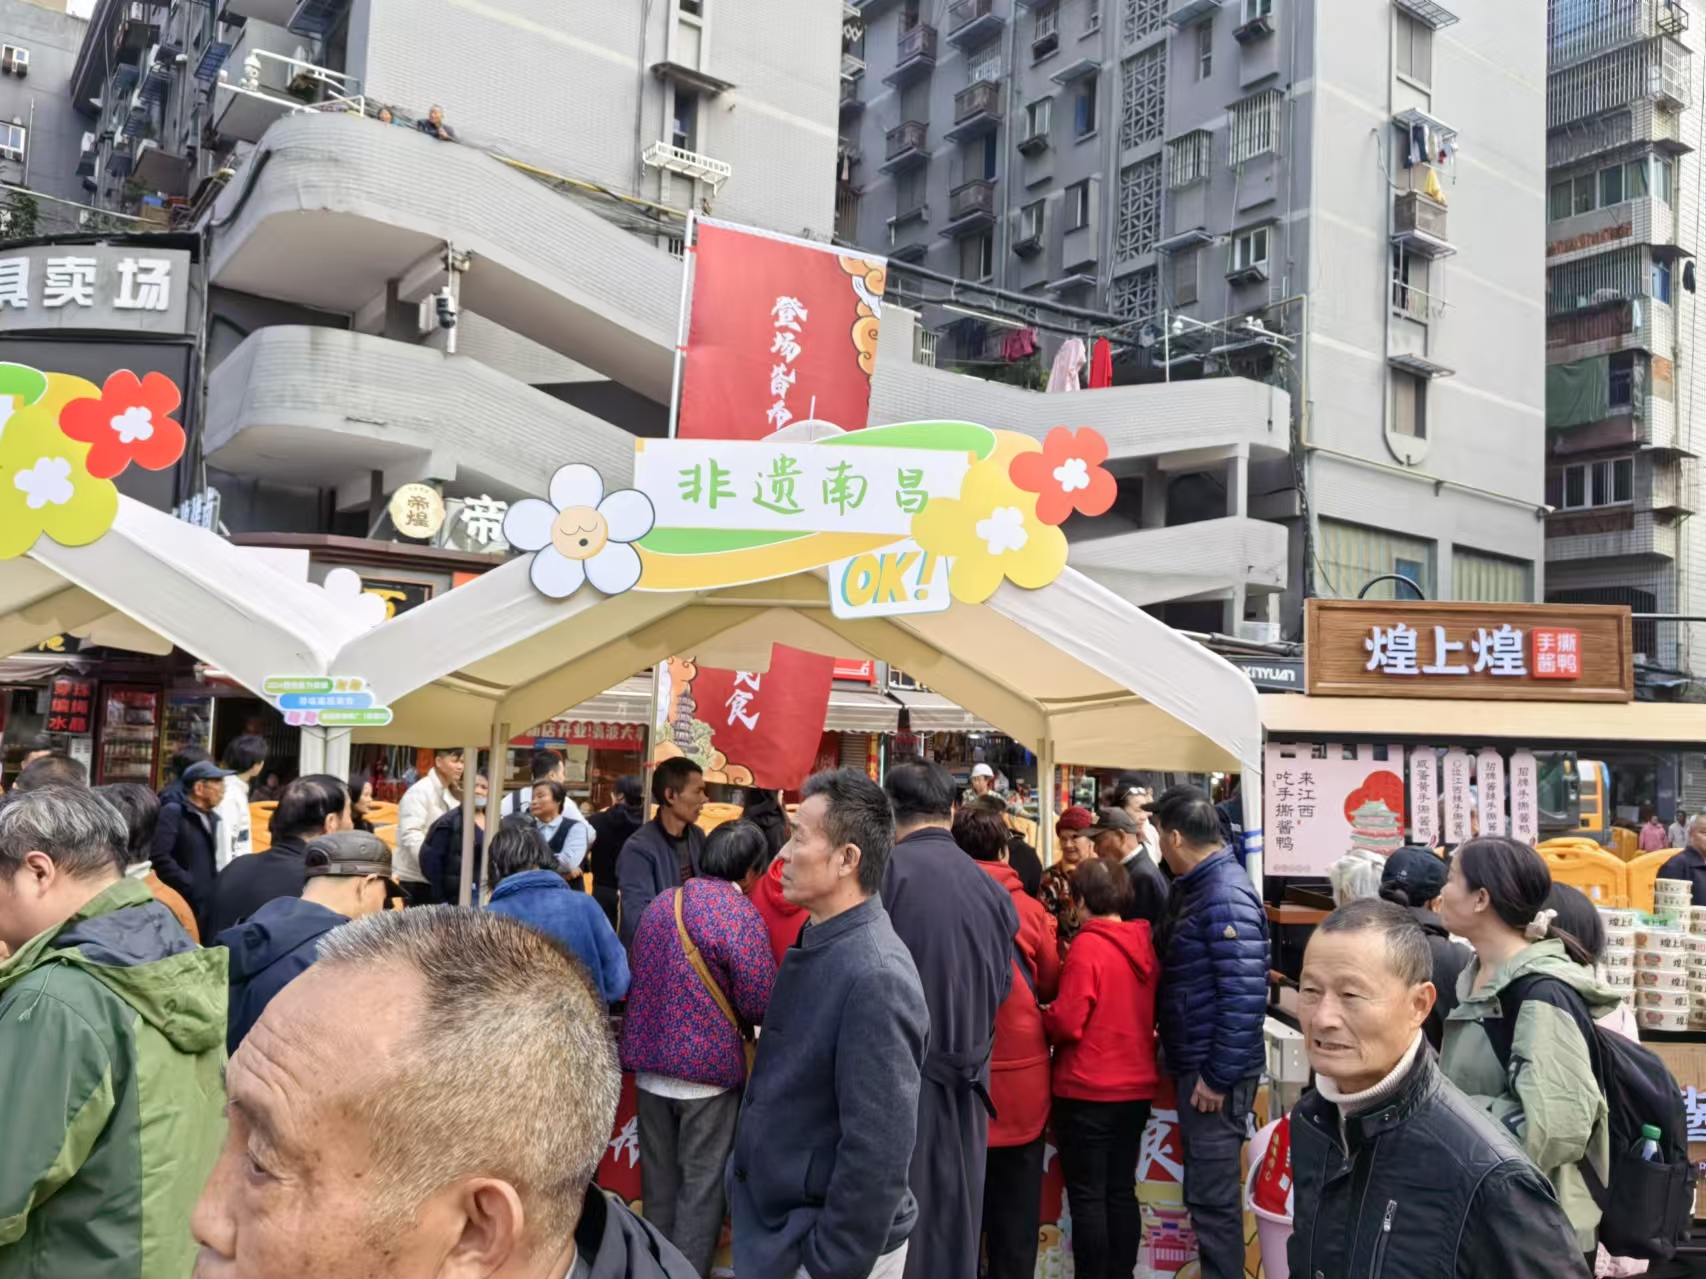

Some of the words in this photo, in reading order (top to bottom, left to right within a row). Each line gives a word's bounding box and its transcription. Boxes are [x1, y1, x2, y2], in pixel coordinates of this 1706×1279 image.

[678, 452, 929, 516] 非遗南昌
[841, 551, 938, 607] OK!
[1364, 622, 1528, 675] 煌上煌
[1537, 633, 1577, 653] 手撕
[1537, 653, 1577, 673] 酱鸭
[1275, 770, 1294, 851] 吃手撕酱鸭
[1298, 770, 1316, 818] 来江西
